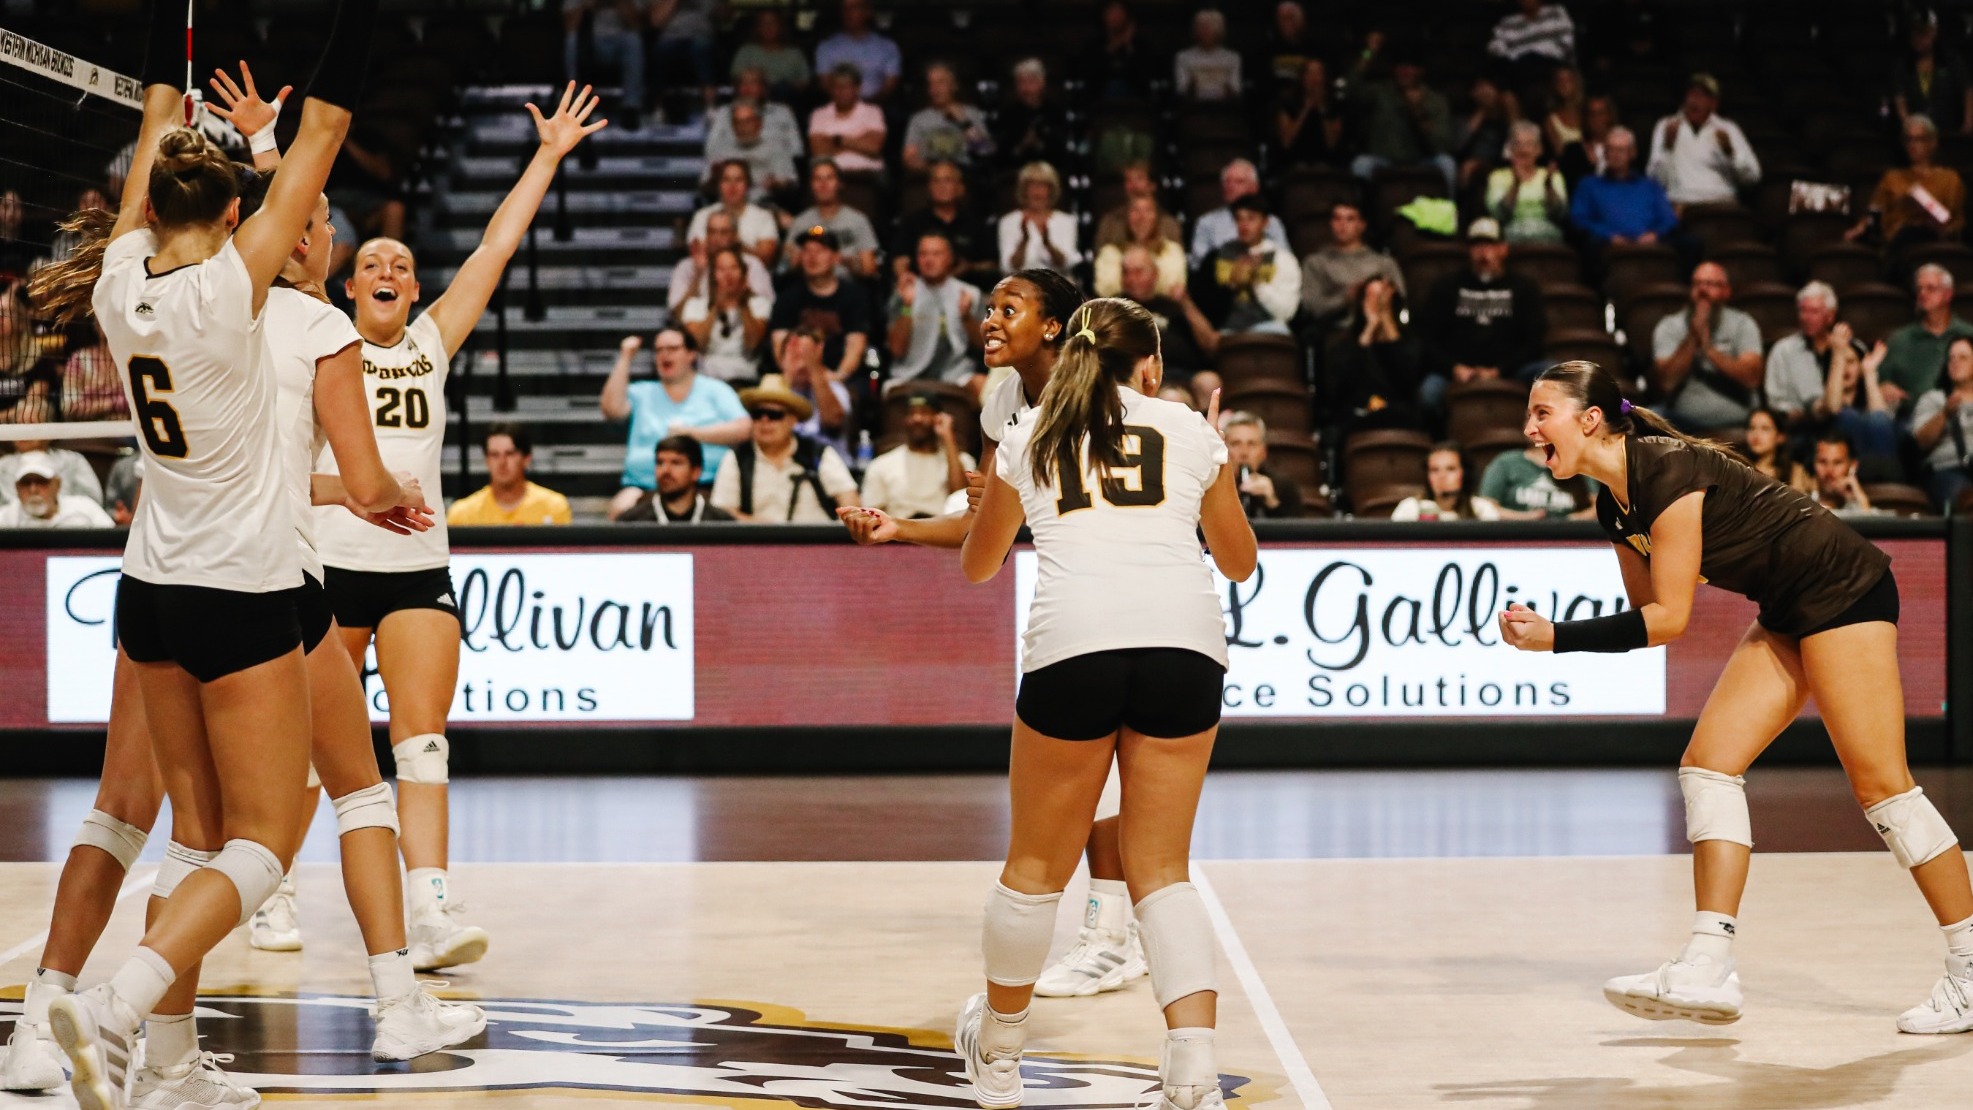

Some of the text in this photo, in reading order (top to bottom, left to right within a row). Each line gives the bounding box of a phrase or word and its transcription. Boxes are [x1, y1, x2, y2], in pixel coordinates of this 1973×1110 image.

[127, 353, 189, 459] 6
[376, 387, 429, 428] 20
[1055, 424, 1167, 517] 19
[458, 568, 678, 652] llivan
[1304, 561, 1625, 671] Galla
[373, 680, 597, 712] otions
[1308, 674, 1571, 707] Solutions
